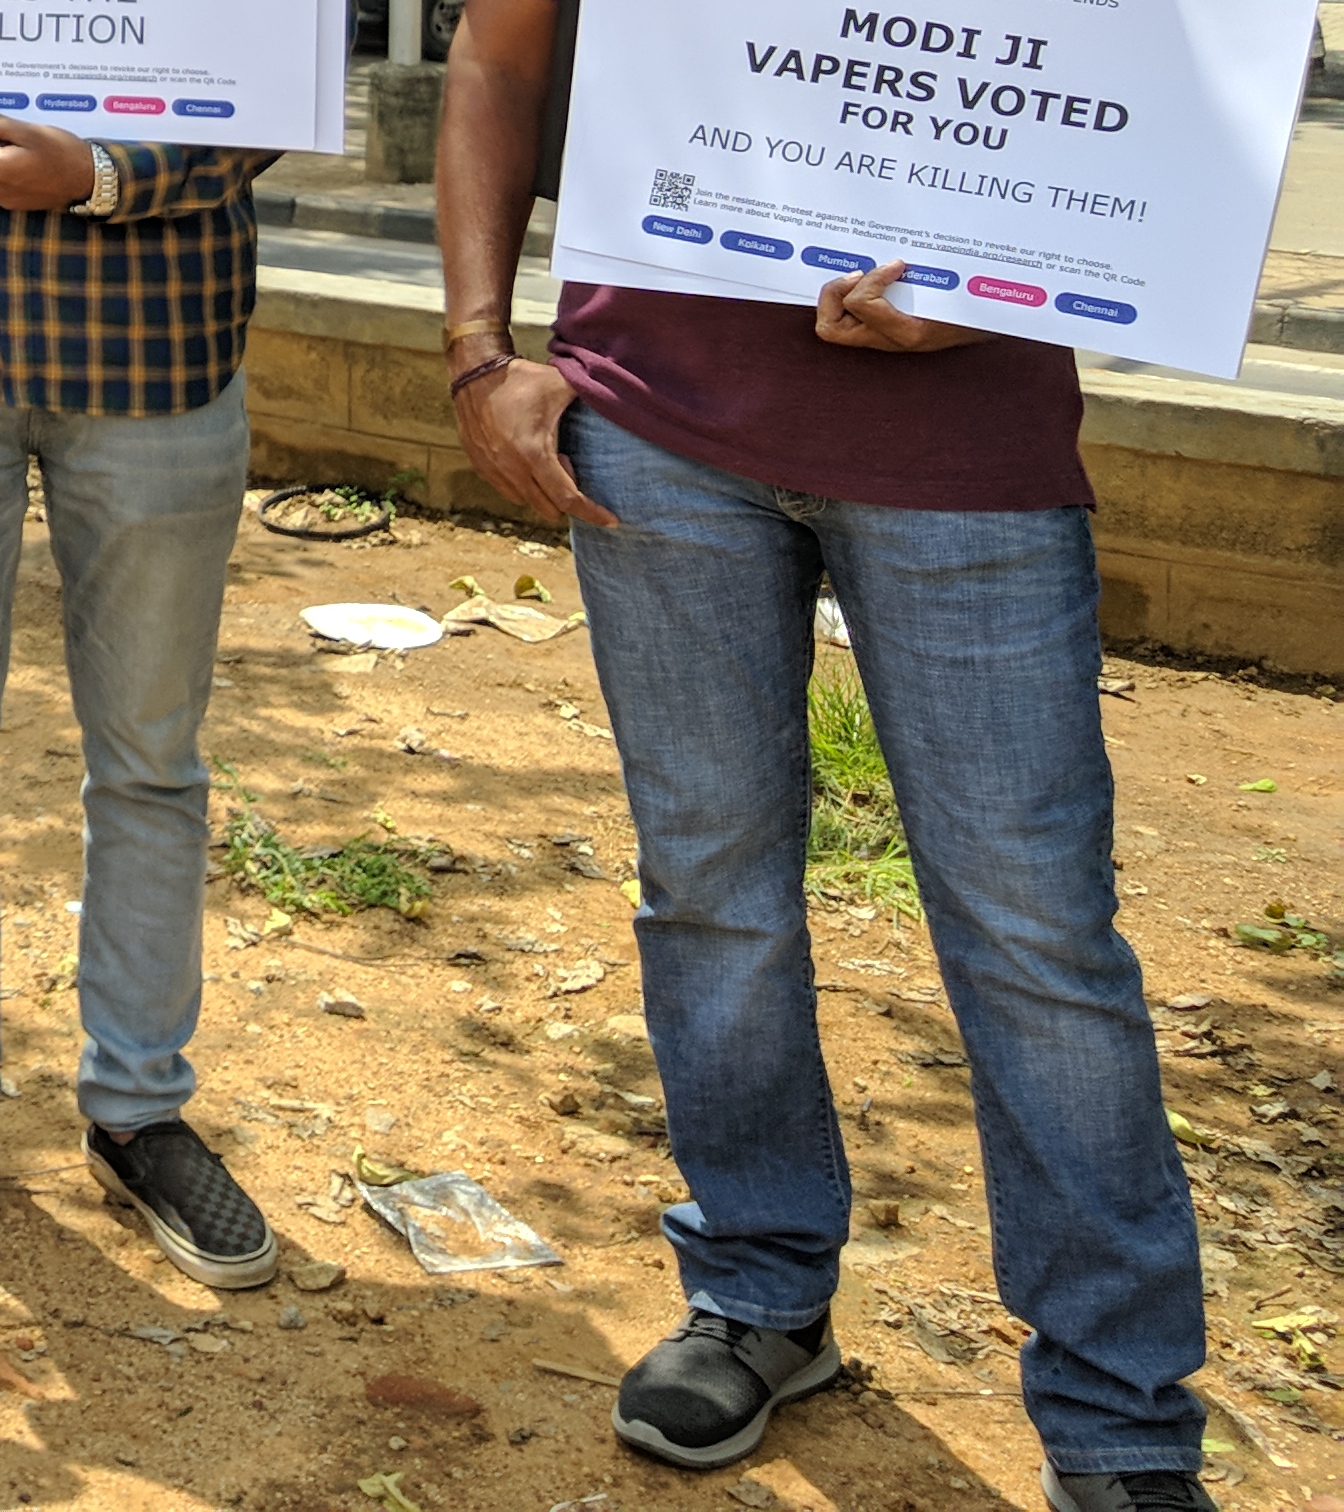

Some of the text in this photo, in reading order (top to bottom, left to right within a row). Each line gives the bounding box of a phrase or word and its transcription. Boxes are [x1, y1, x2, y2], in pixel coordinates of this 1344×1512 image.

[839, 7, 1048, 70] MODI JI
[745, 41, 1128, 132] VAPERS VOTED
[113, 101, 156, 111] Bengaluru
[186, 104, 221, 113] Chennai
[839, 101, 1008, 150] FOR YOU
[688, 124, 1147, 222] AND YOU ARE KILLING THEM!
[652, 221, 702, 239] New Delhi
[692, 197, 718, 208] Learn
[719, 203, 743, 213] more
[744, 208, 771, 219] about
[773, 212, 803, 226] Vaping
[804, 219, 823, 229] and
[824, 222, 850, 234] Harm
[851, 227, 897, 242] Reduction
[898, 236, 909, 245] @
[1045, 262, 1056, 270] or
[1058, 265, 1081, 275] scan
[1083, 268, 1101, 279] the
[1102, 271, 1118, 282] QR
[1120, 275, 1146, 287] Code
[738, 238, 775, 253] Kolkata
[818, 254, 859, 269] Mumbai
[900, 270, 949, 285] yderabad
[980, 283, 1034, 300] Bengaluru
[1073, 300, 1118, 316] Chennai
